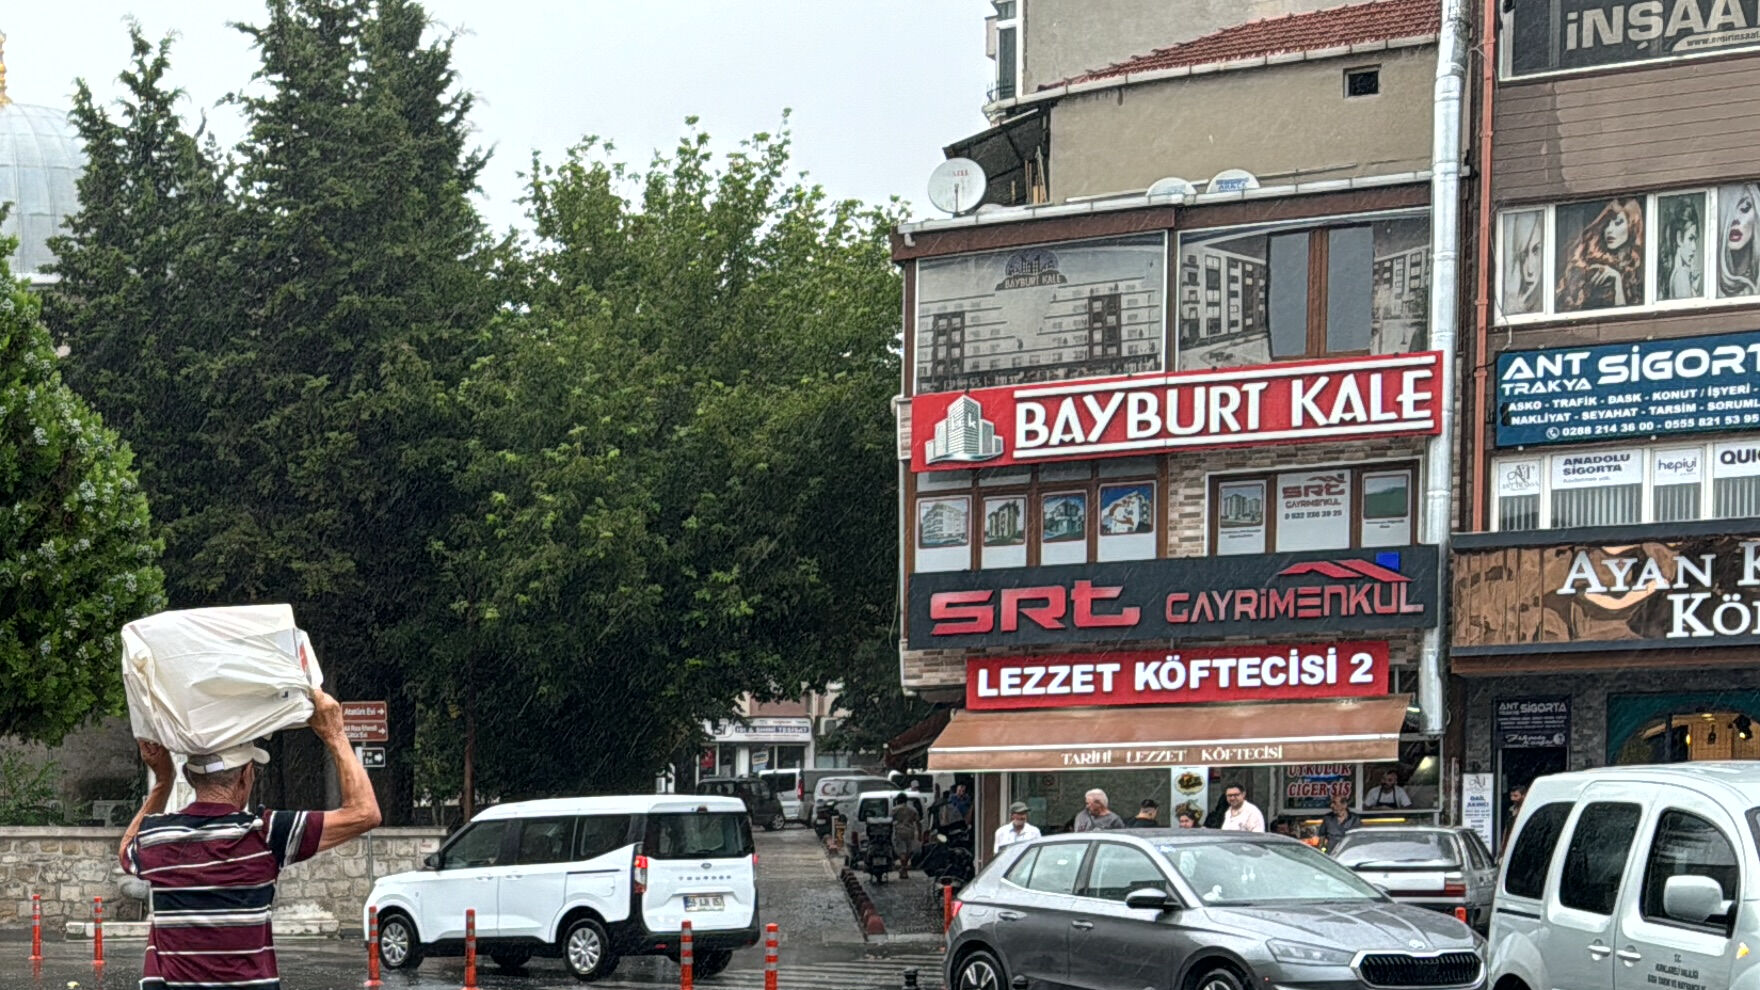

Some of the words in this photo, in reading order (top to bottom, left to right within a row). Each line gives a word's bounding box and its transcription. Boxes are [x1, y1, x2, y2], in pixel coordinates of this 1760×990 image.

[1566, 0, 1760, 50] İNŞAA
[1501, 351, 1591, 381] ANT
[1500, 378, 1593, 396] TRAKYA
[1507, 401, 1542, 412] ASKO
[1552, 396, 1598, 409] TRAFİK
[1652, 389, 1698, 402] KONUT
[1707, 383, 1751, 399] İŞYERİ
[1014, 381, 1268, 449] BAYBURT
[1290, 369, 1434, 429] KALE
[1511, 412, 1572, 426] NAKLİYAT
[1581, 408, 1639, 421] SEYAHAT
[1648, 402, 1697, 416] TARSİM
[1594, 423, 1618, 434] 214
[1638, 421, 1654, 432] 00
[1562, 453, 1631, 467] ANADOLU
[1720, 448, 1760, 465] QUI
[1562, 463, 1623, 477] SİGORTA
[1556, 551, 1717, 595] AYAN
[977, 662, 1121, 697] LEZZET
[1134, 647, 1338, 691] KÖFTECİSİ
[1349, 652, 1374, 683] 2
[1520, 702, 1567, 713] SİGORTA
[1061, 750, 1112, 765] TARİHİ
[1126, 749, 1187, 763] LEZZET
[1201, 744, 1283, 761] KÖFTECİSİ
